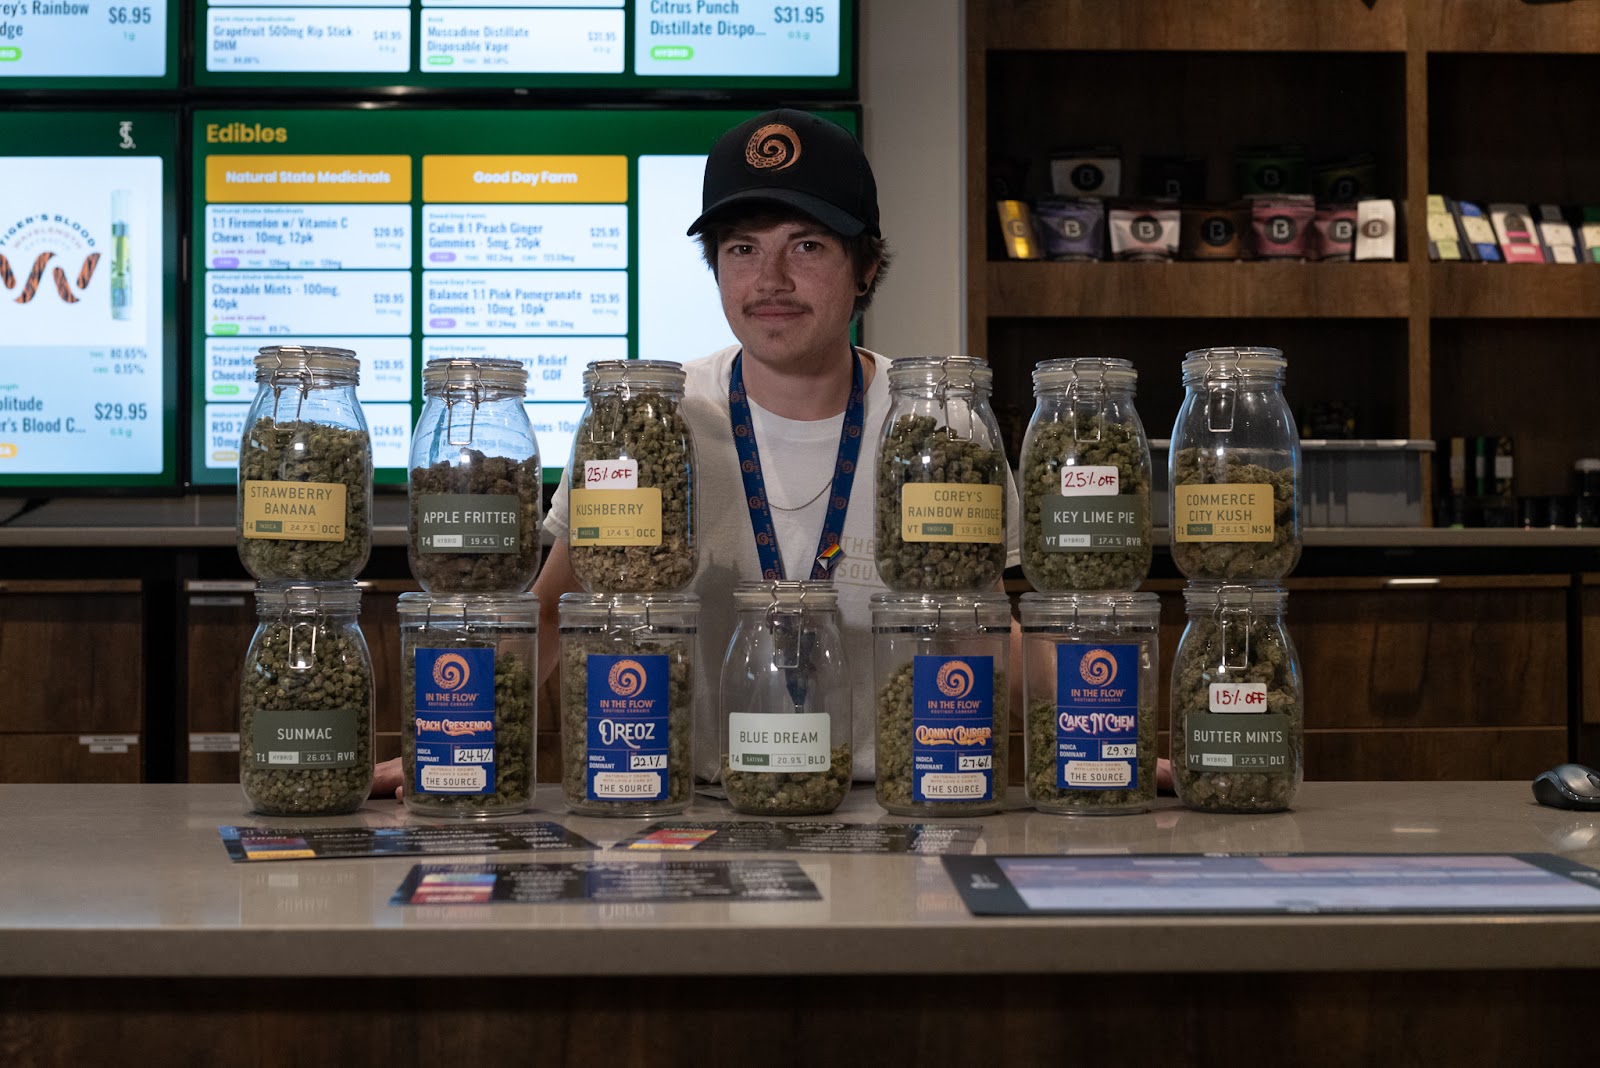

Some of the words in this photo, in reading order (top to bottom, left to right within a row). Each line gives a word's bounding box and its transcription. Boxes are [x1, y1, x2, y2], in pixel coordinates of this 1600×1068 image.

[32, 0, 89, 15] Rainbow
[650, 0, 692, 14] Citrus
[697, 0, 739, 14] Punch
[108, 6, 152, 24] $6.95
[774, 6, 824, 23] $31.95
[650, 20, 712, 35] Distillate
[206, 122, 288, 143] Edibles
[225, 170, 277, 183] Natural
[279, 170, 315, 183] State
[317, 170, 391, 183] Medicinals
[473, 170, 510, 184] Good
[512, 171, 539, 186] Day
[541, 171, 578, 184] Farm
[299, 217, 338, 229] Vitamin
[341, 217, 348, 228] C
[94, 402, 147, 421] $29.95
[22, 418, 61, 433] Blood
[587, 467, 607, 482] 25%
[611, 468, 632, 479] OFF
[1064, 471, 1095, 487] 25%
[1098, 476, 1116, 487] OFF
[250, 486, 333, 500] STRAWBERRY
[934, 490, 983, 503] COREY'S
[1186, 494, 1256, 506] COMMERCE
[264, 502, 316, 516] BANANA
[576, 503, 644, 516] KUSHBERRY
[908, 506, 963, 518] RAINBOW
[967, 507, 1000, 520] BRIDGE
[1189, 510, 1212, 522] CITY
[1217, 509, 1252, 521] KUSH
[423, 511, 460, 523] APPLE
[464, 511, 516, 524] FRITTER
[1053, 511, 1079, 523] KEY
[1083, 511, 1114, 523] LIME
[1118, 512, 1135, 524] PIE
[321, 525, 340, 534] OCC
[636, 528, 656, 537] OCC
[907, 525, 919, 533] VT
[1252, 525, 1272, 534] NSM
[421, 537, 431, 546] T4
[503, 537, 515, 546] CF
[1045, 536, 1056, 545] VT
[1126, 537, 1142, 546] RVR
[425, 693, 435, 701] IN
[436, 693, 450, 701] THE
[452, 693, 476, 702] FLOW
[1071, 689, 1081, 697] IN
[1082, 689, 1098, 697] THE
[1100, 689, 1123, 698] FLOW
[1216, 689, 1242, 705] 15%
[1245, 691, 1266, 704] OFF
[600, 700, 610, 708] IN
[611, 700, 626, 708] THE
[629, 700, 653, 708] FLOW
[928, 700, 938, 709] IN
[940, 700, 955, 709] THE
[957, 700, 980, 709] FLOW
[441, 718, 492, 736] CRESCENDO
[1105, 713, 1135, 733] CHEM
[277, 727, 333, 740] SUNMAC
[598, 718, 655, 749] OREOZ
[740, 731, 769, 743] BLUE
[774, 731, 818, 743] DREAM
[915, 725, 954, 747] DONNY
[953, 725, 992, 746] BURGER
[1193, 730, 1241, 743] BUTTER
[1246, 731, 1283, 743] MINTS
[256, 753, 266, 762] T1
[337, 752, 355, 761] RVR
[458, 748, 491, 762] 24.4%
[731, 754, 740, 763] T4
[808, 755, 826, 765] BLD
[1189, 754, 1200, 764] VT
[1270, 756, 1285, 765] DLT
[633, 756, 662, 768] 22.1%
[961, 758, 990, 768] 27.6%
[425, 777, 440, 785] THE
[1070, 772, 1087, 780] THE
[600, 784, 615, 792] THE
[927, 785, 943, 793] THE
